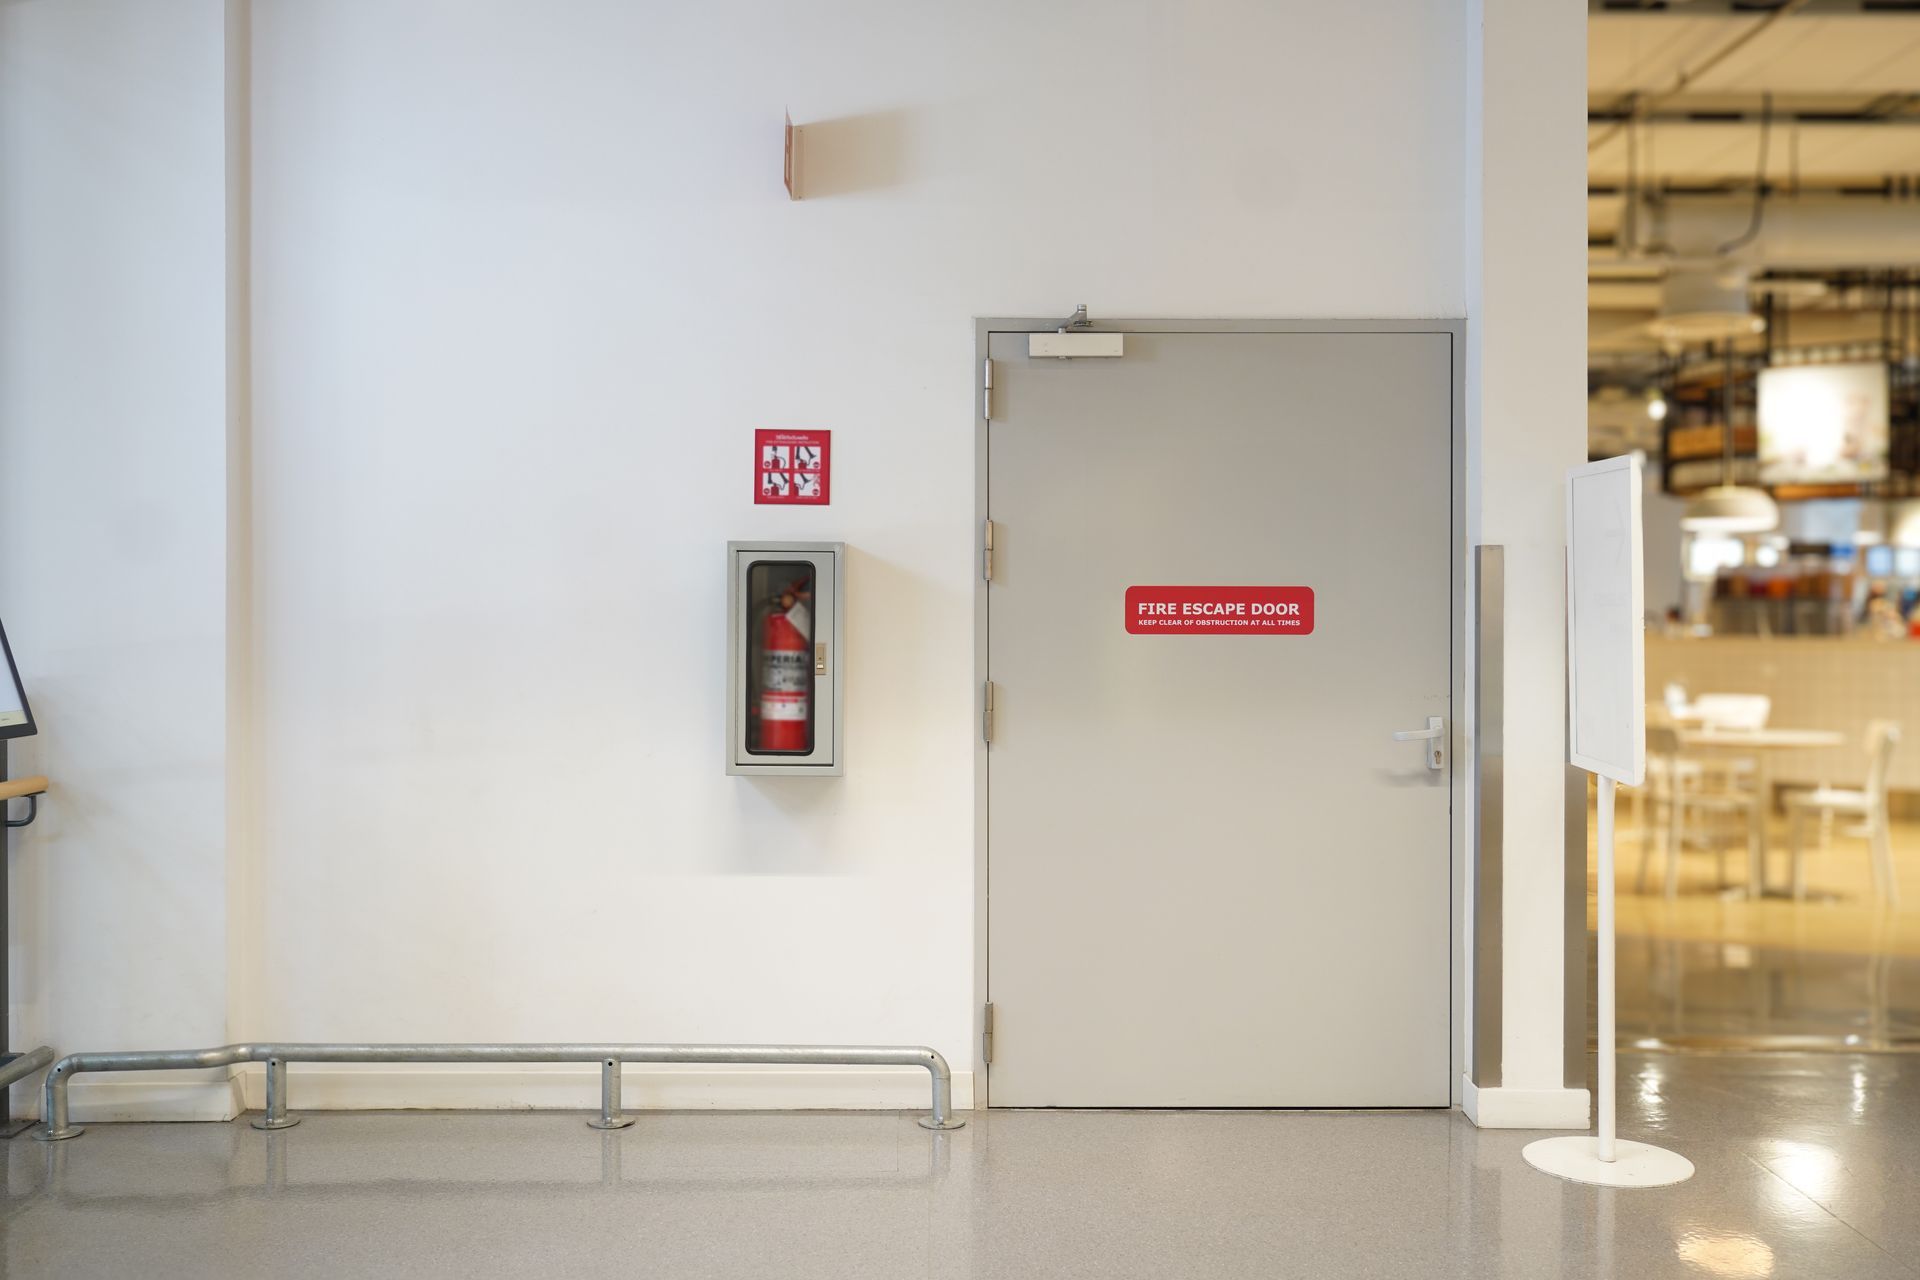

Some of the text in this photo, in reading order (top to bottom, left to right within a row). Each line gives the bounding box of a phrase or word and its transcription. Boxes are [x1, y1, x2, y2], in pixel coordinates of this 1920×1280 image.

[1138, 603, 1300, 615] FIRE ESCAPE DOOR
